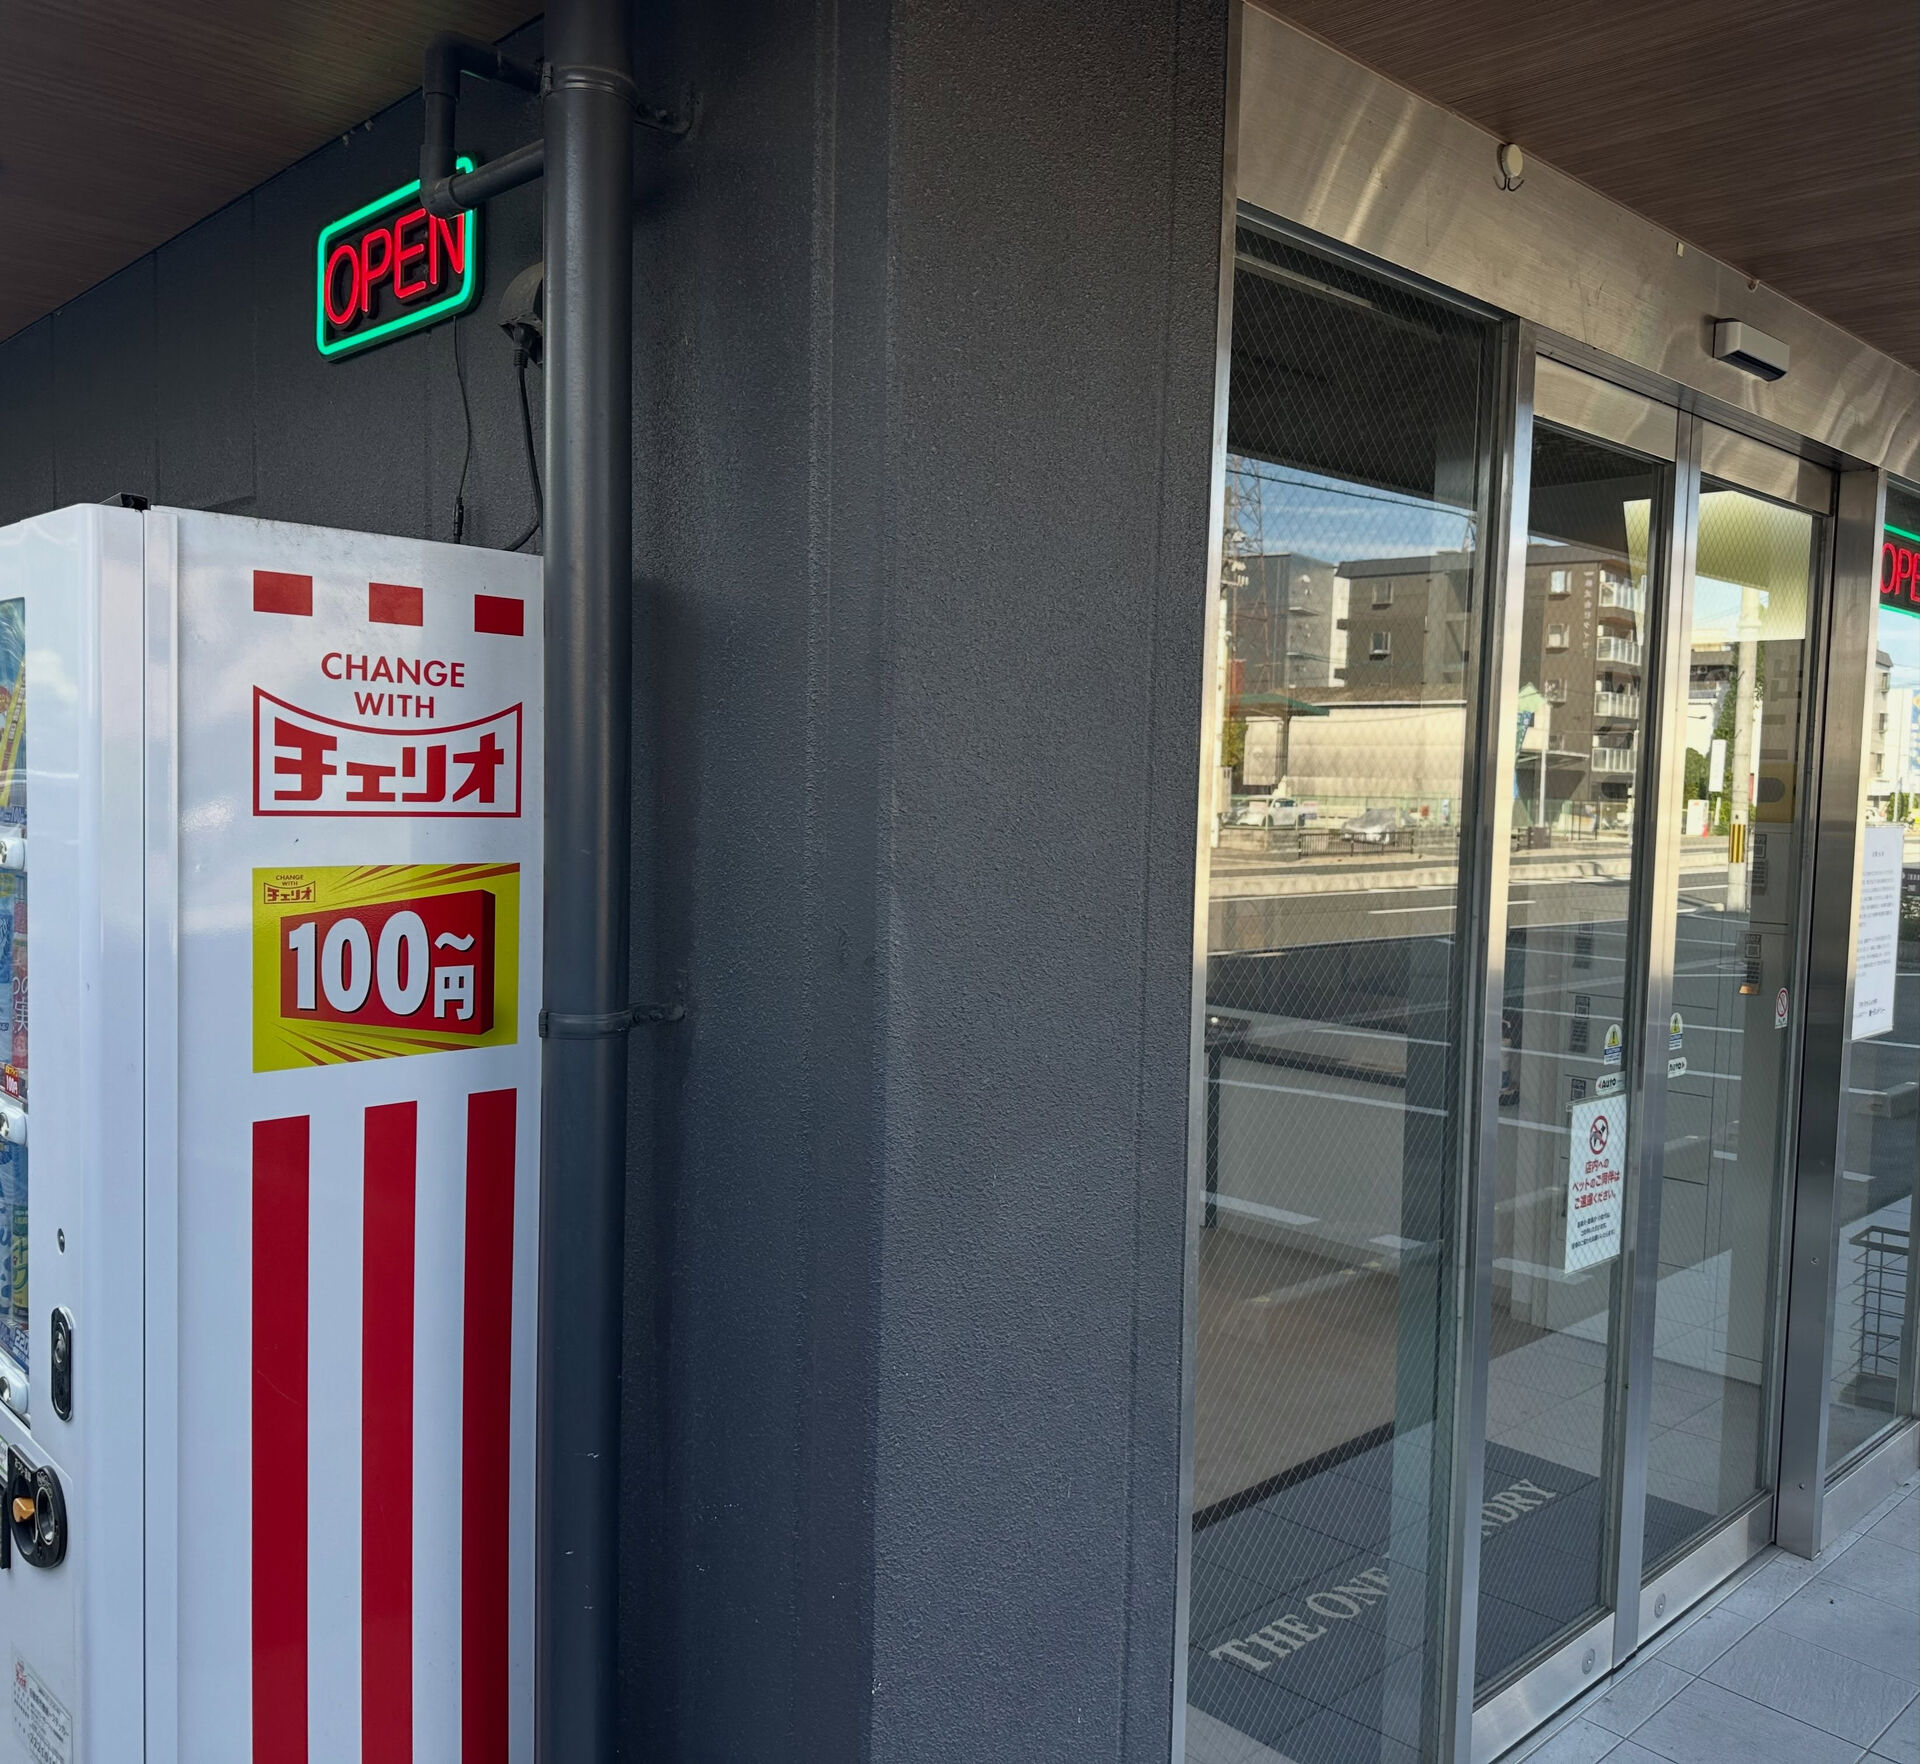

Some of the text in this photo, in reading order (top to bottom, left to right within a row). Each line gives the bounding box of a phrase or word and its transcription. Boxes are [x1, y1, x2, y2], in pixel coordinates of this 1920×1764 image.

[325, 208, 465, 326] OPEN
[321, 652, 465, 688] CHANGE
[354, 692, 435, 718] WITH
[274, 717, 504, 803] チェリオ
[267, 886, 312, 901] チェリオ
[1208, 1614, 1328, 1672] THE
